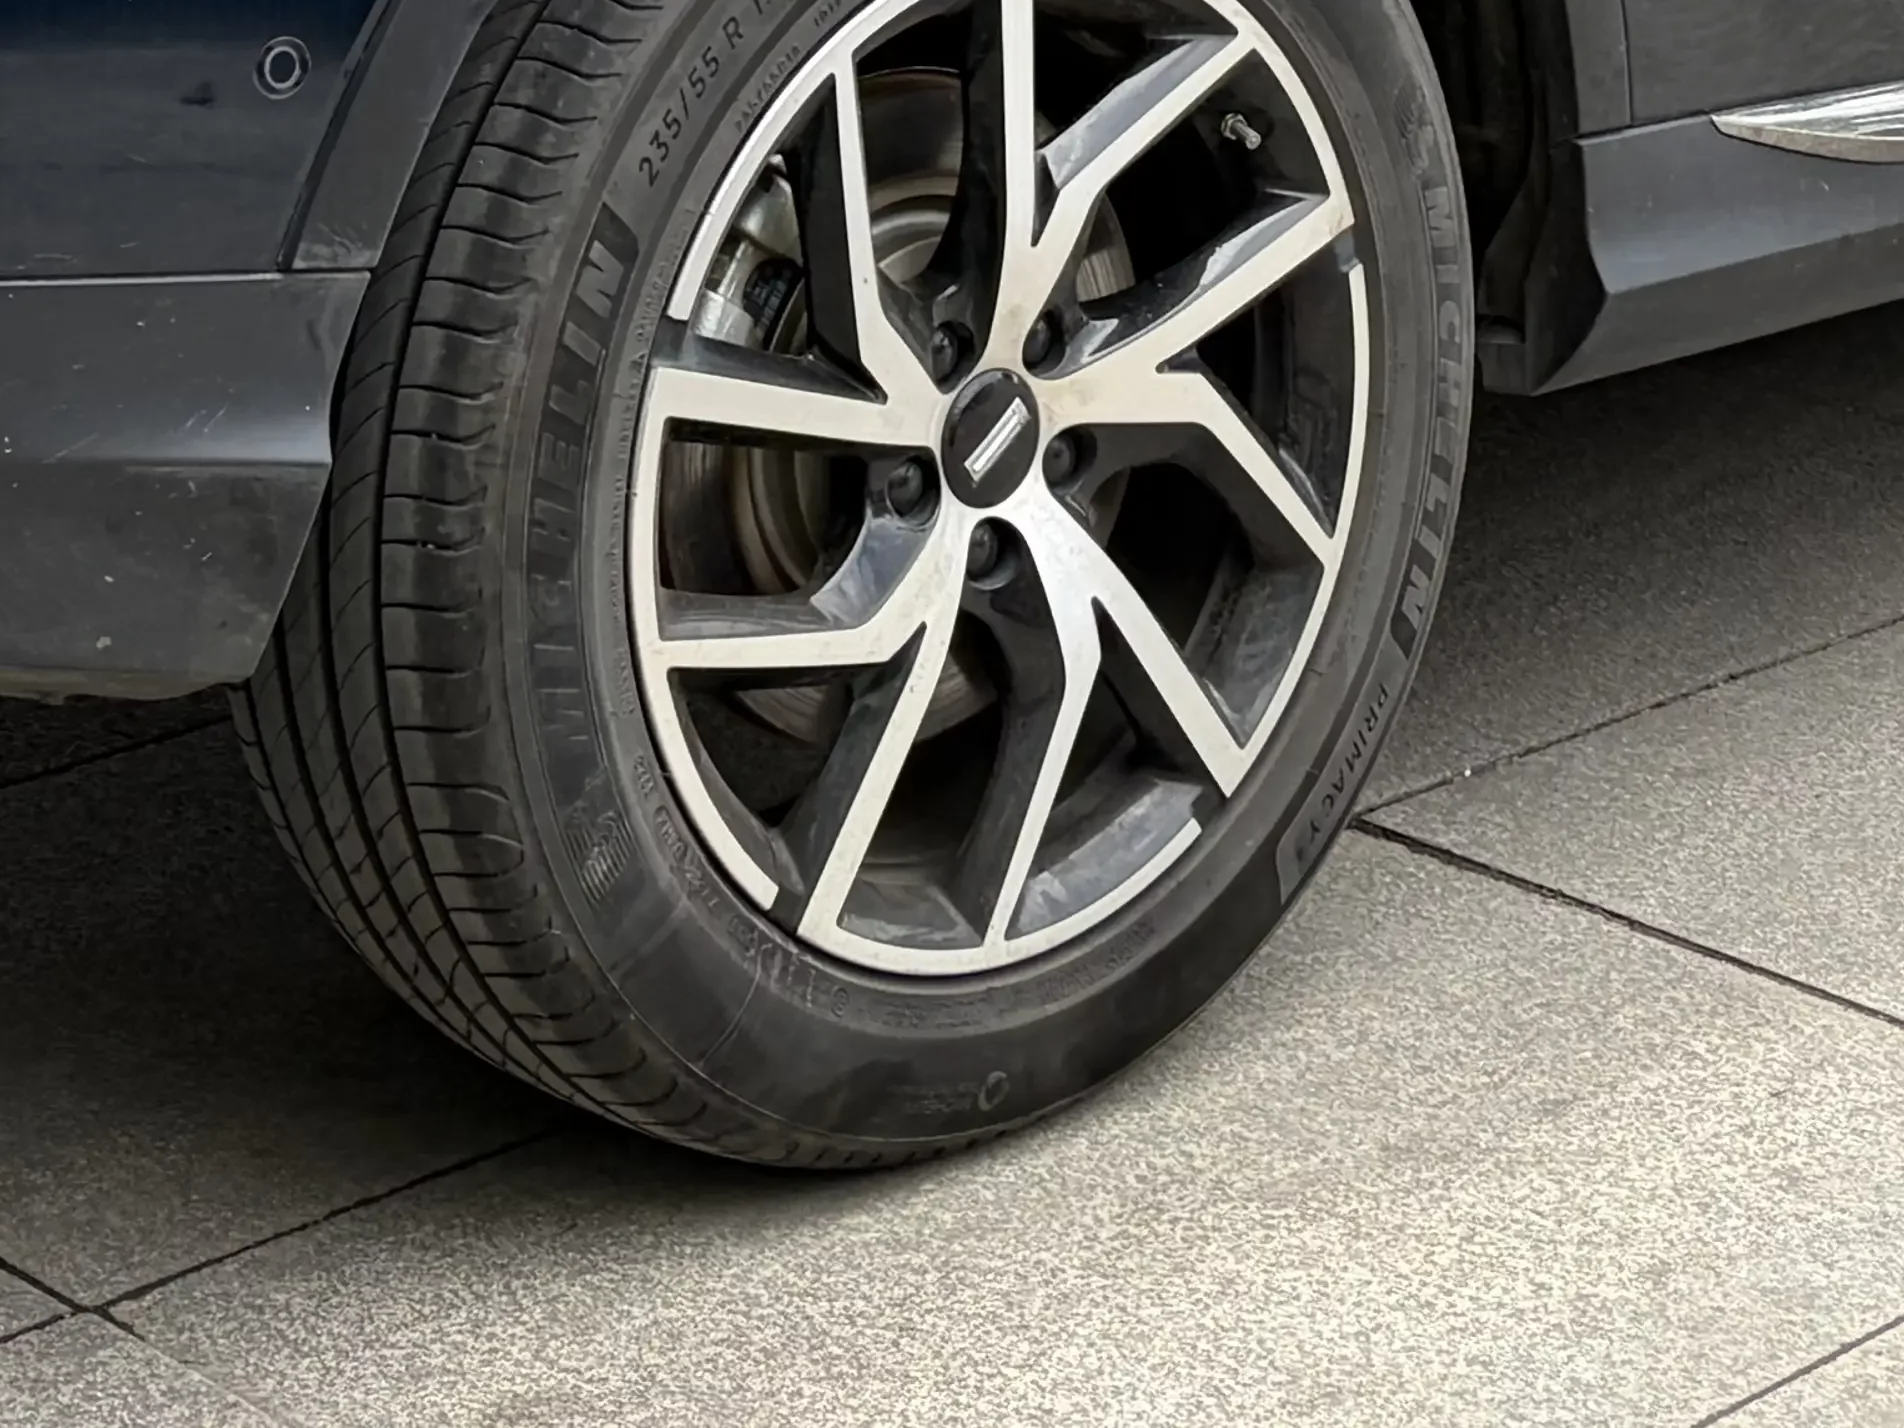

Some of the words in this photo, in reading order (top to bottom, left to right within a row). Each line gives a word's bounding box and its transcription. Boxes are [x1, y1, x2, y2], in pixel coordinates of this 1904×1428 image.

[638, 46, 720, 188] 235/55
[722, 16, 744, 50] R
[1309, 682, 1389, 844] PRIMACY
